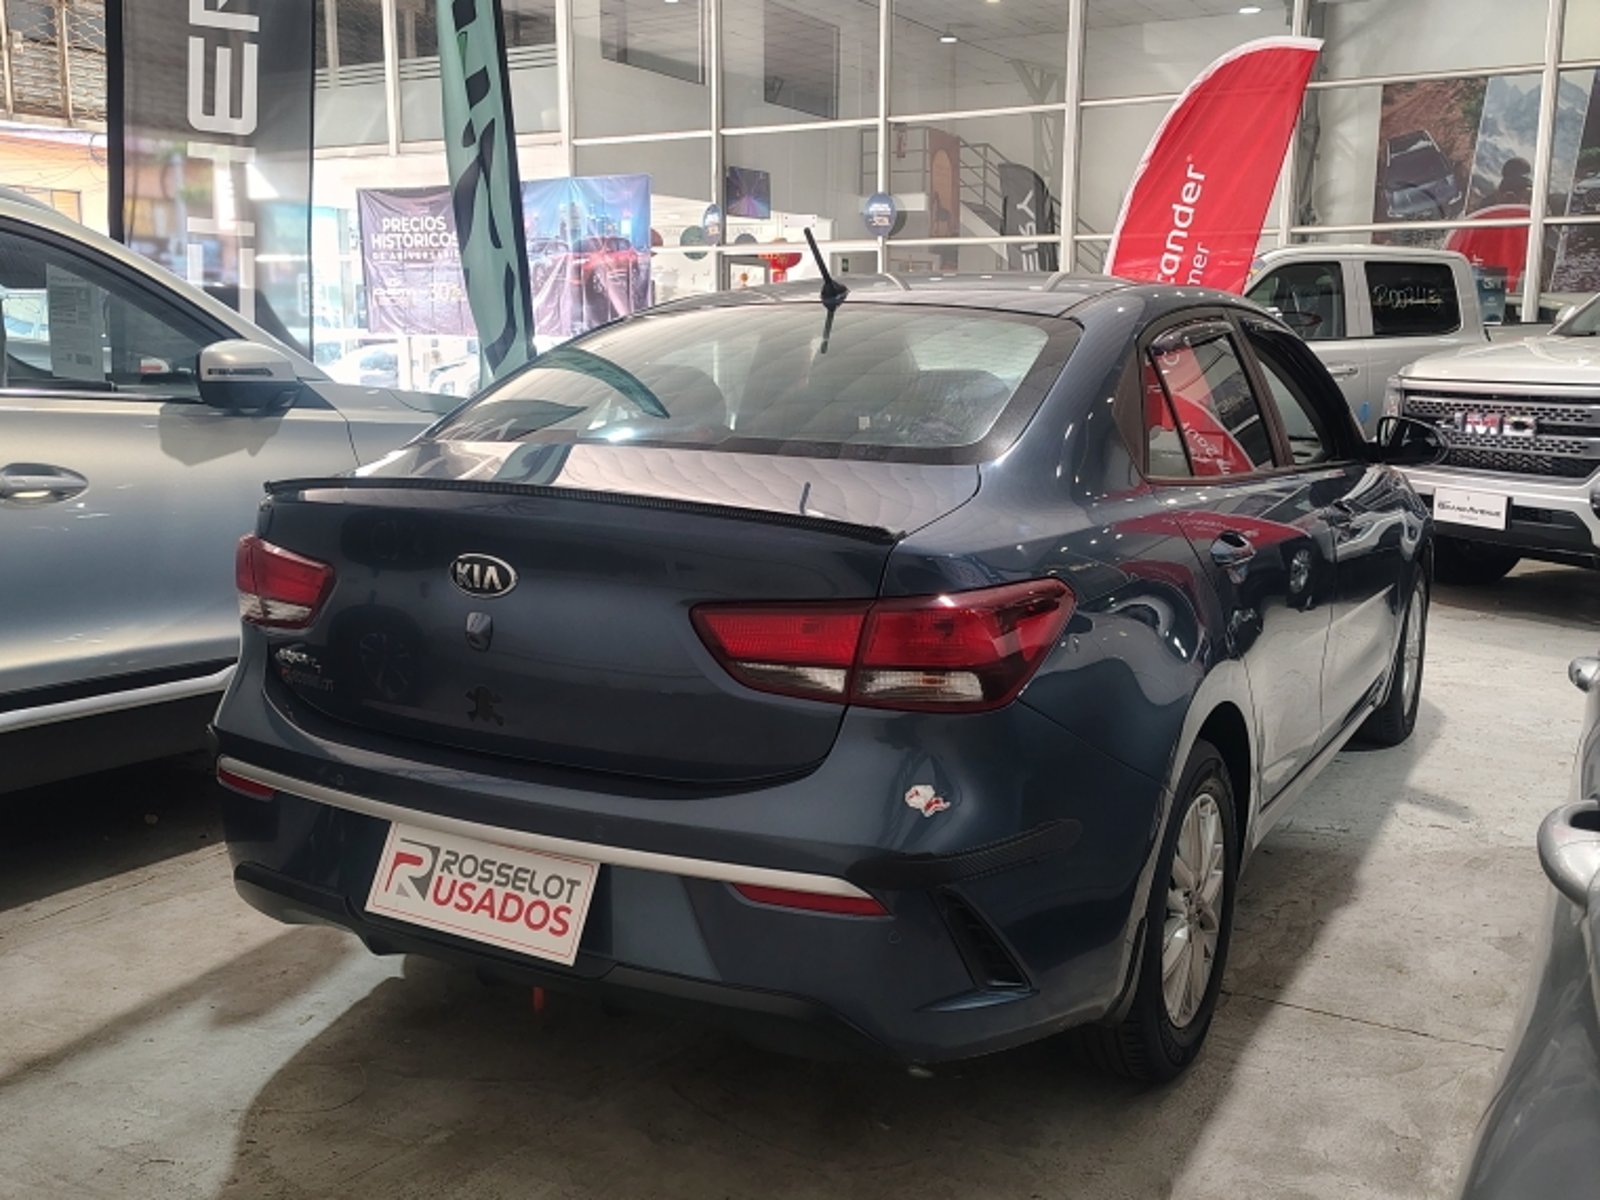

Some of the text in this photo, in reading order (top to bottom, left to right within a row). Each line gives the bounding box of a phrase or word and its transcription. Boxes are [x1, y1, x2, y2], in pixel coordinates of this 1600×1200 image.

[382, 216, 447, 232] PRECIOS
[457, 562, 502, 590] KIA
[441, 850, 581, 903] ROSSELOT
[433, 876, 572, 937] USADOS
